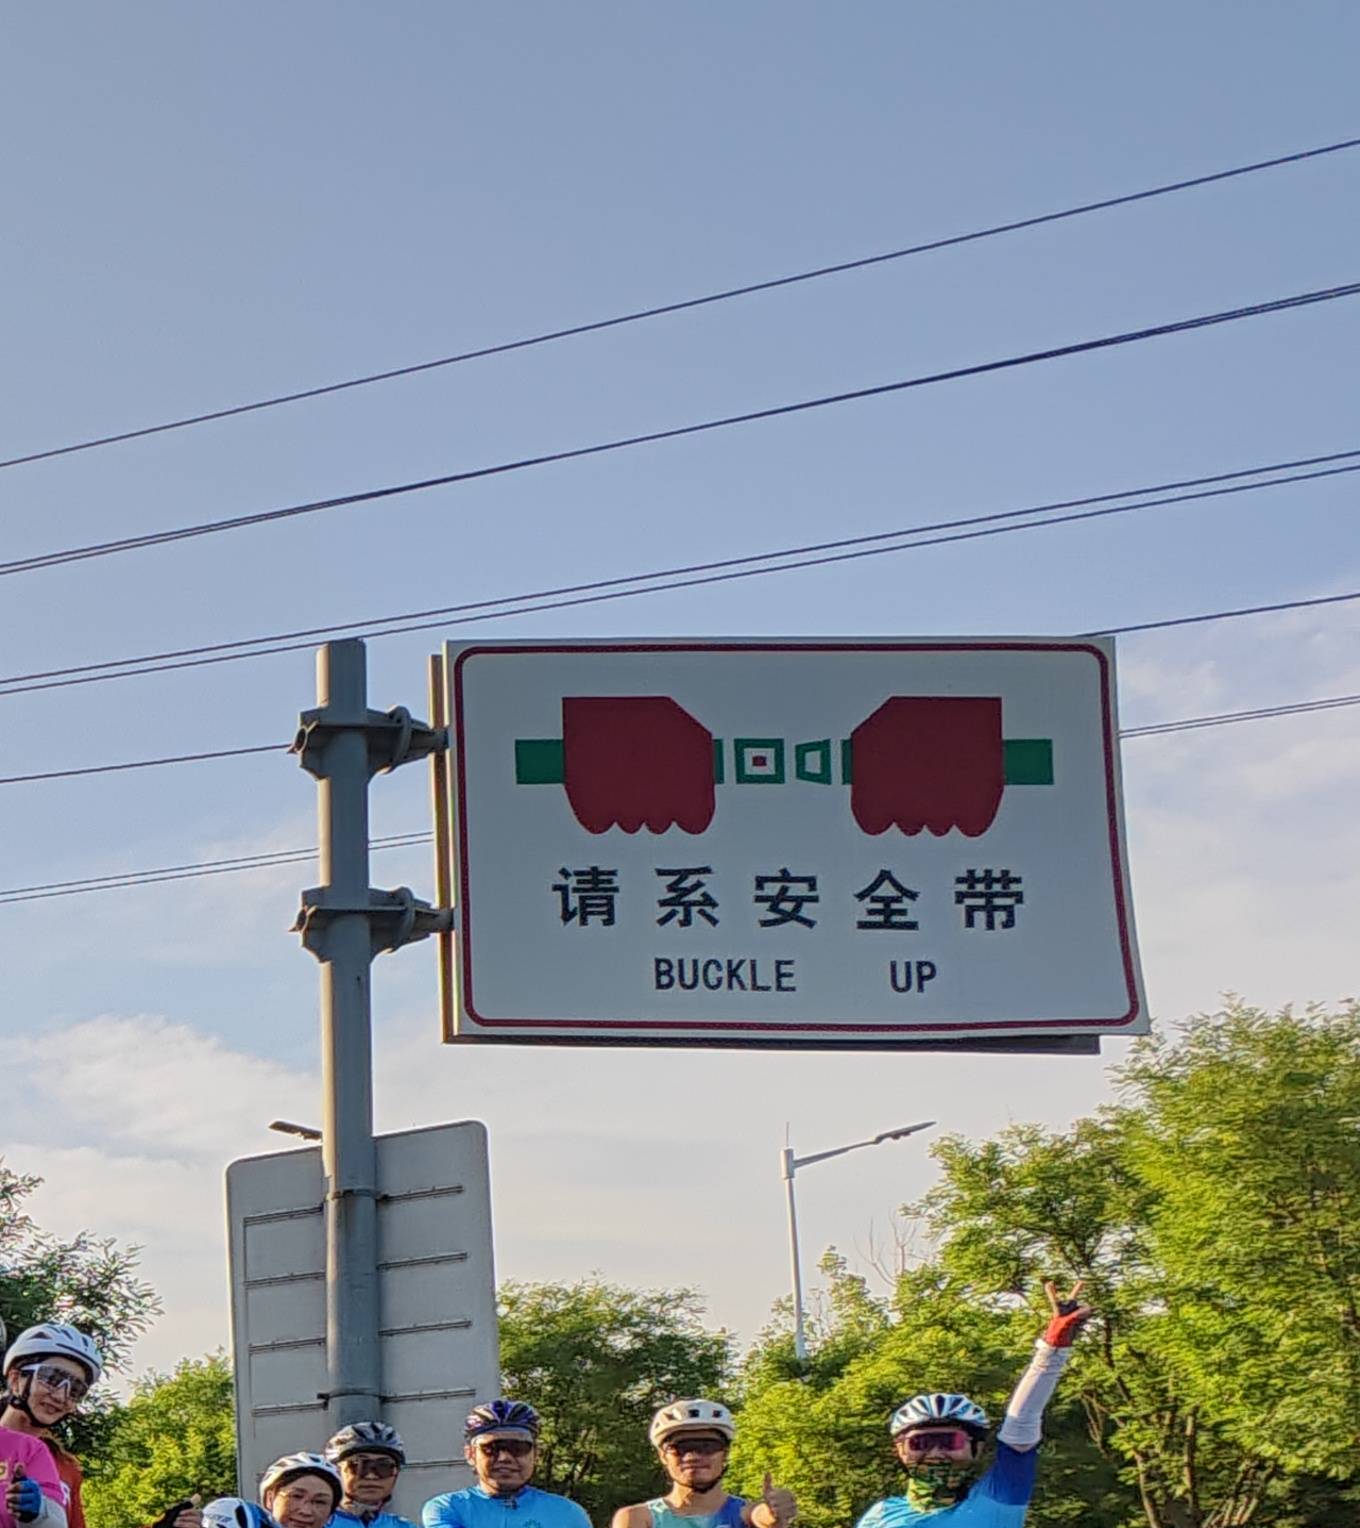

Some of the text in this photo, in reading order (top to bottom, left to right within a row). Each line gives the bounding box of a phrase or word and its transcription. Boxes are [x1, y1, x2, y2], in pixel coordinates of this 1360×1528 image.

[552, 866, 1025, 932] 请系安全带
[654, 957, 937, 994] BUCKLE UP
